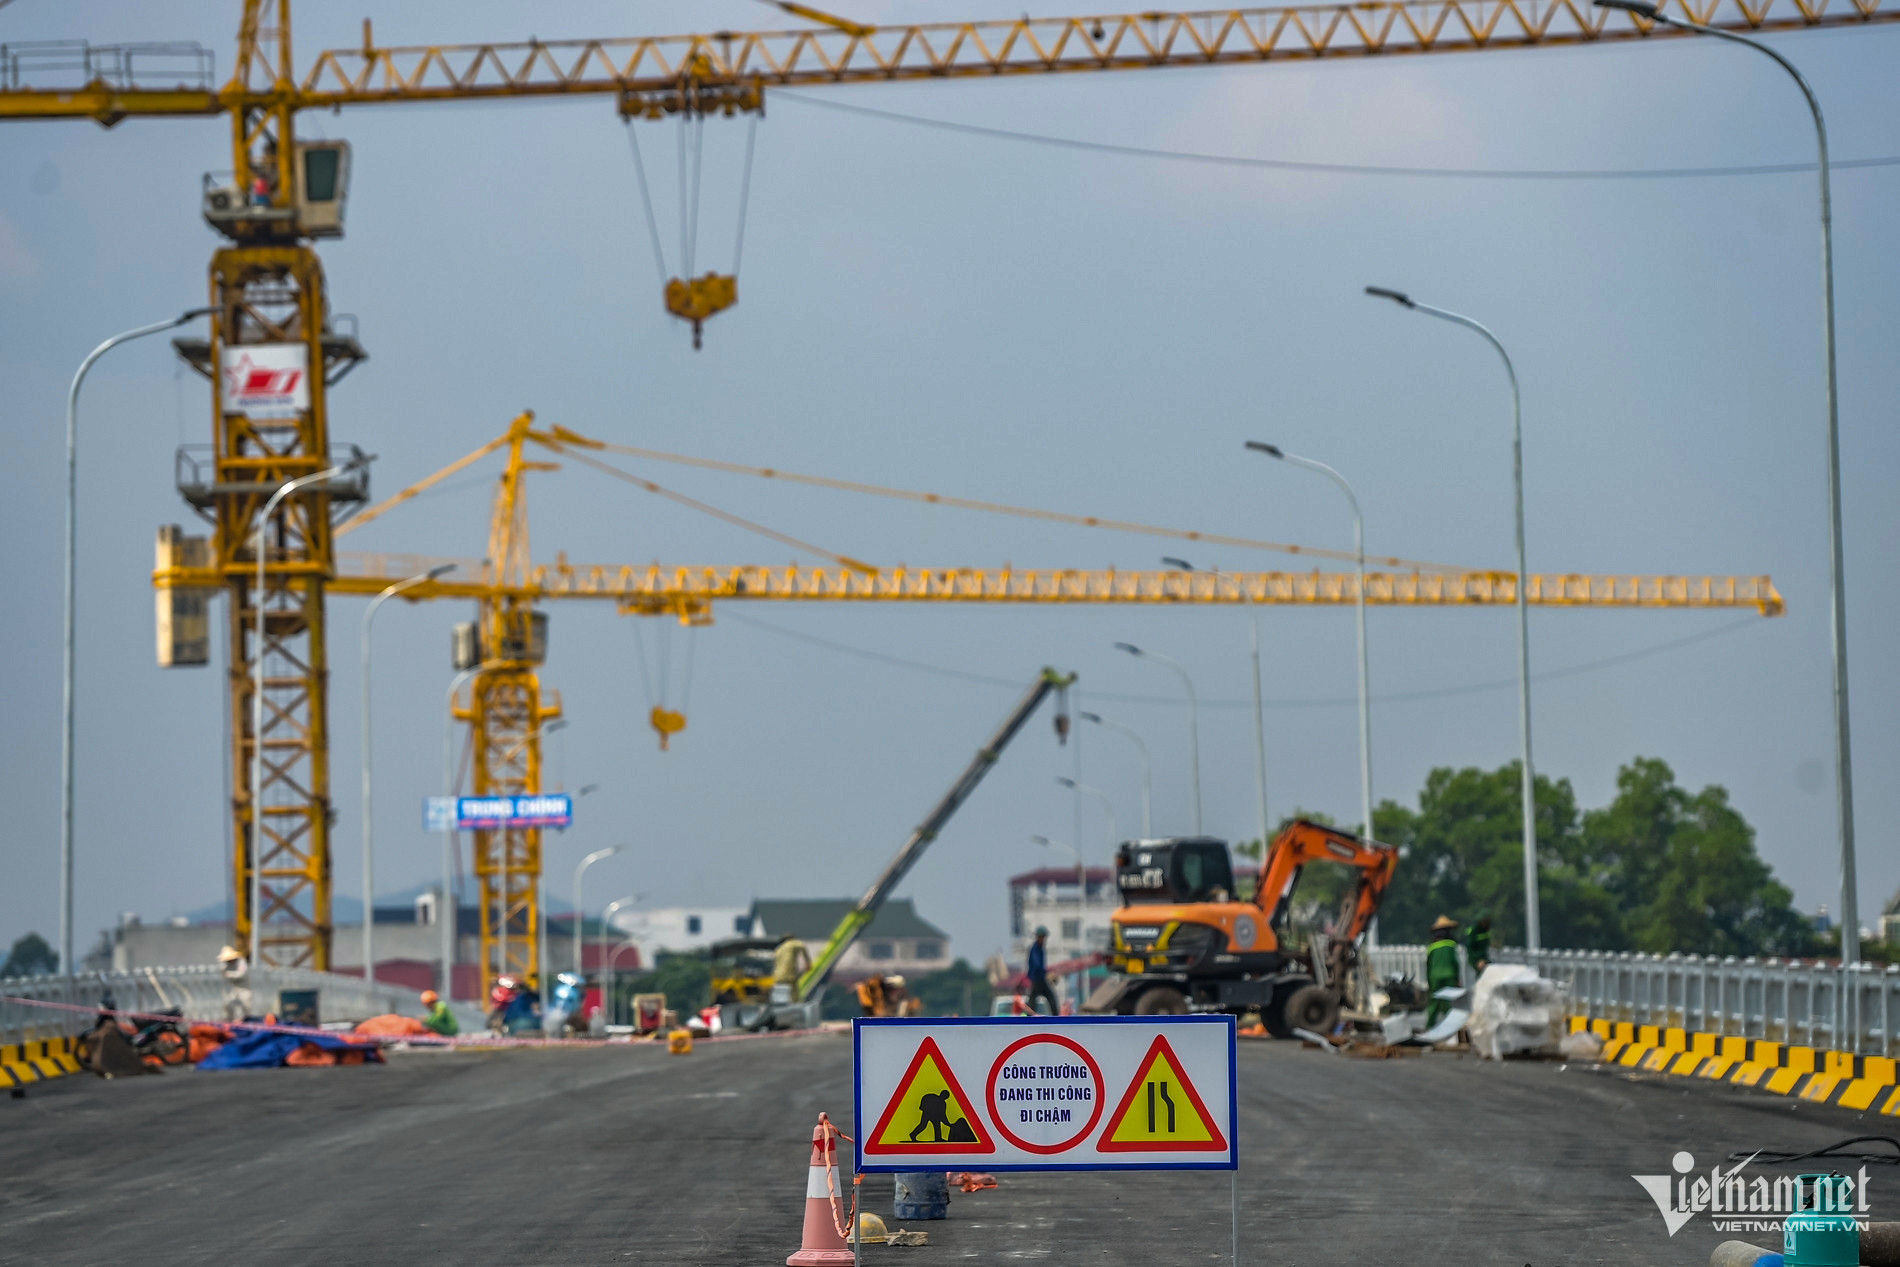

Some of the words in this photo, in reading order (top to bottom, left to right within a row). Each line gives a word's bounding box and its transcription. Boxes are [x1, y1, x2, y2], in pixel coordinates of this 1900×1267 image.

[1003, 1064, 1036, 1079] CÔNG
[1039, 1063, 1088, 1079] TRƯỜNG
[999, 1087, 1033, 1101] ĐANG
[1036, 1087, 1055, 1101] THI
[1058, 1085, 1092, 1101] CÔNG
[1020, 1109, 1033, 1123] ĐI
[1035, 1107, 1071, 1125] CHẬM
